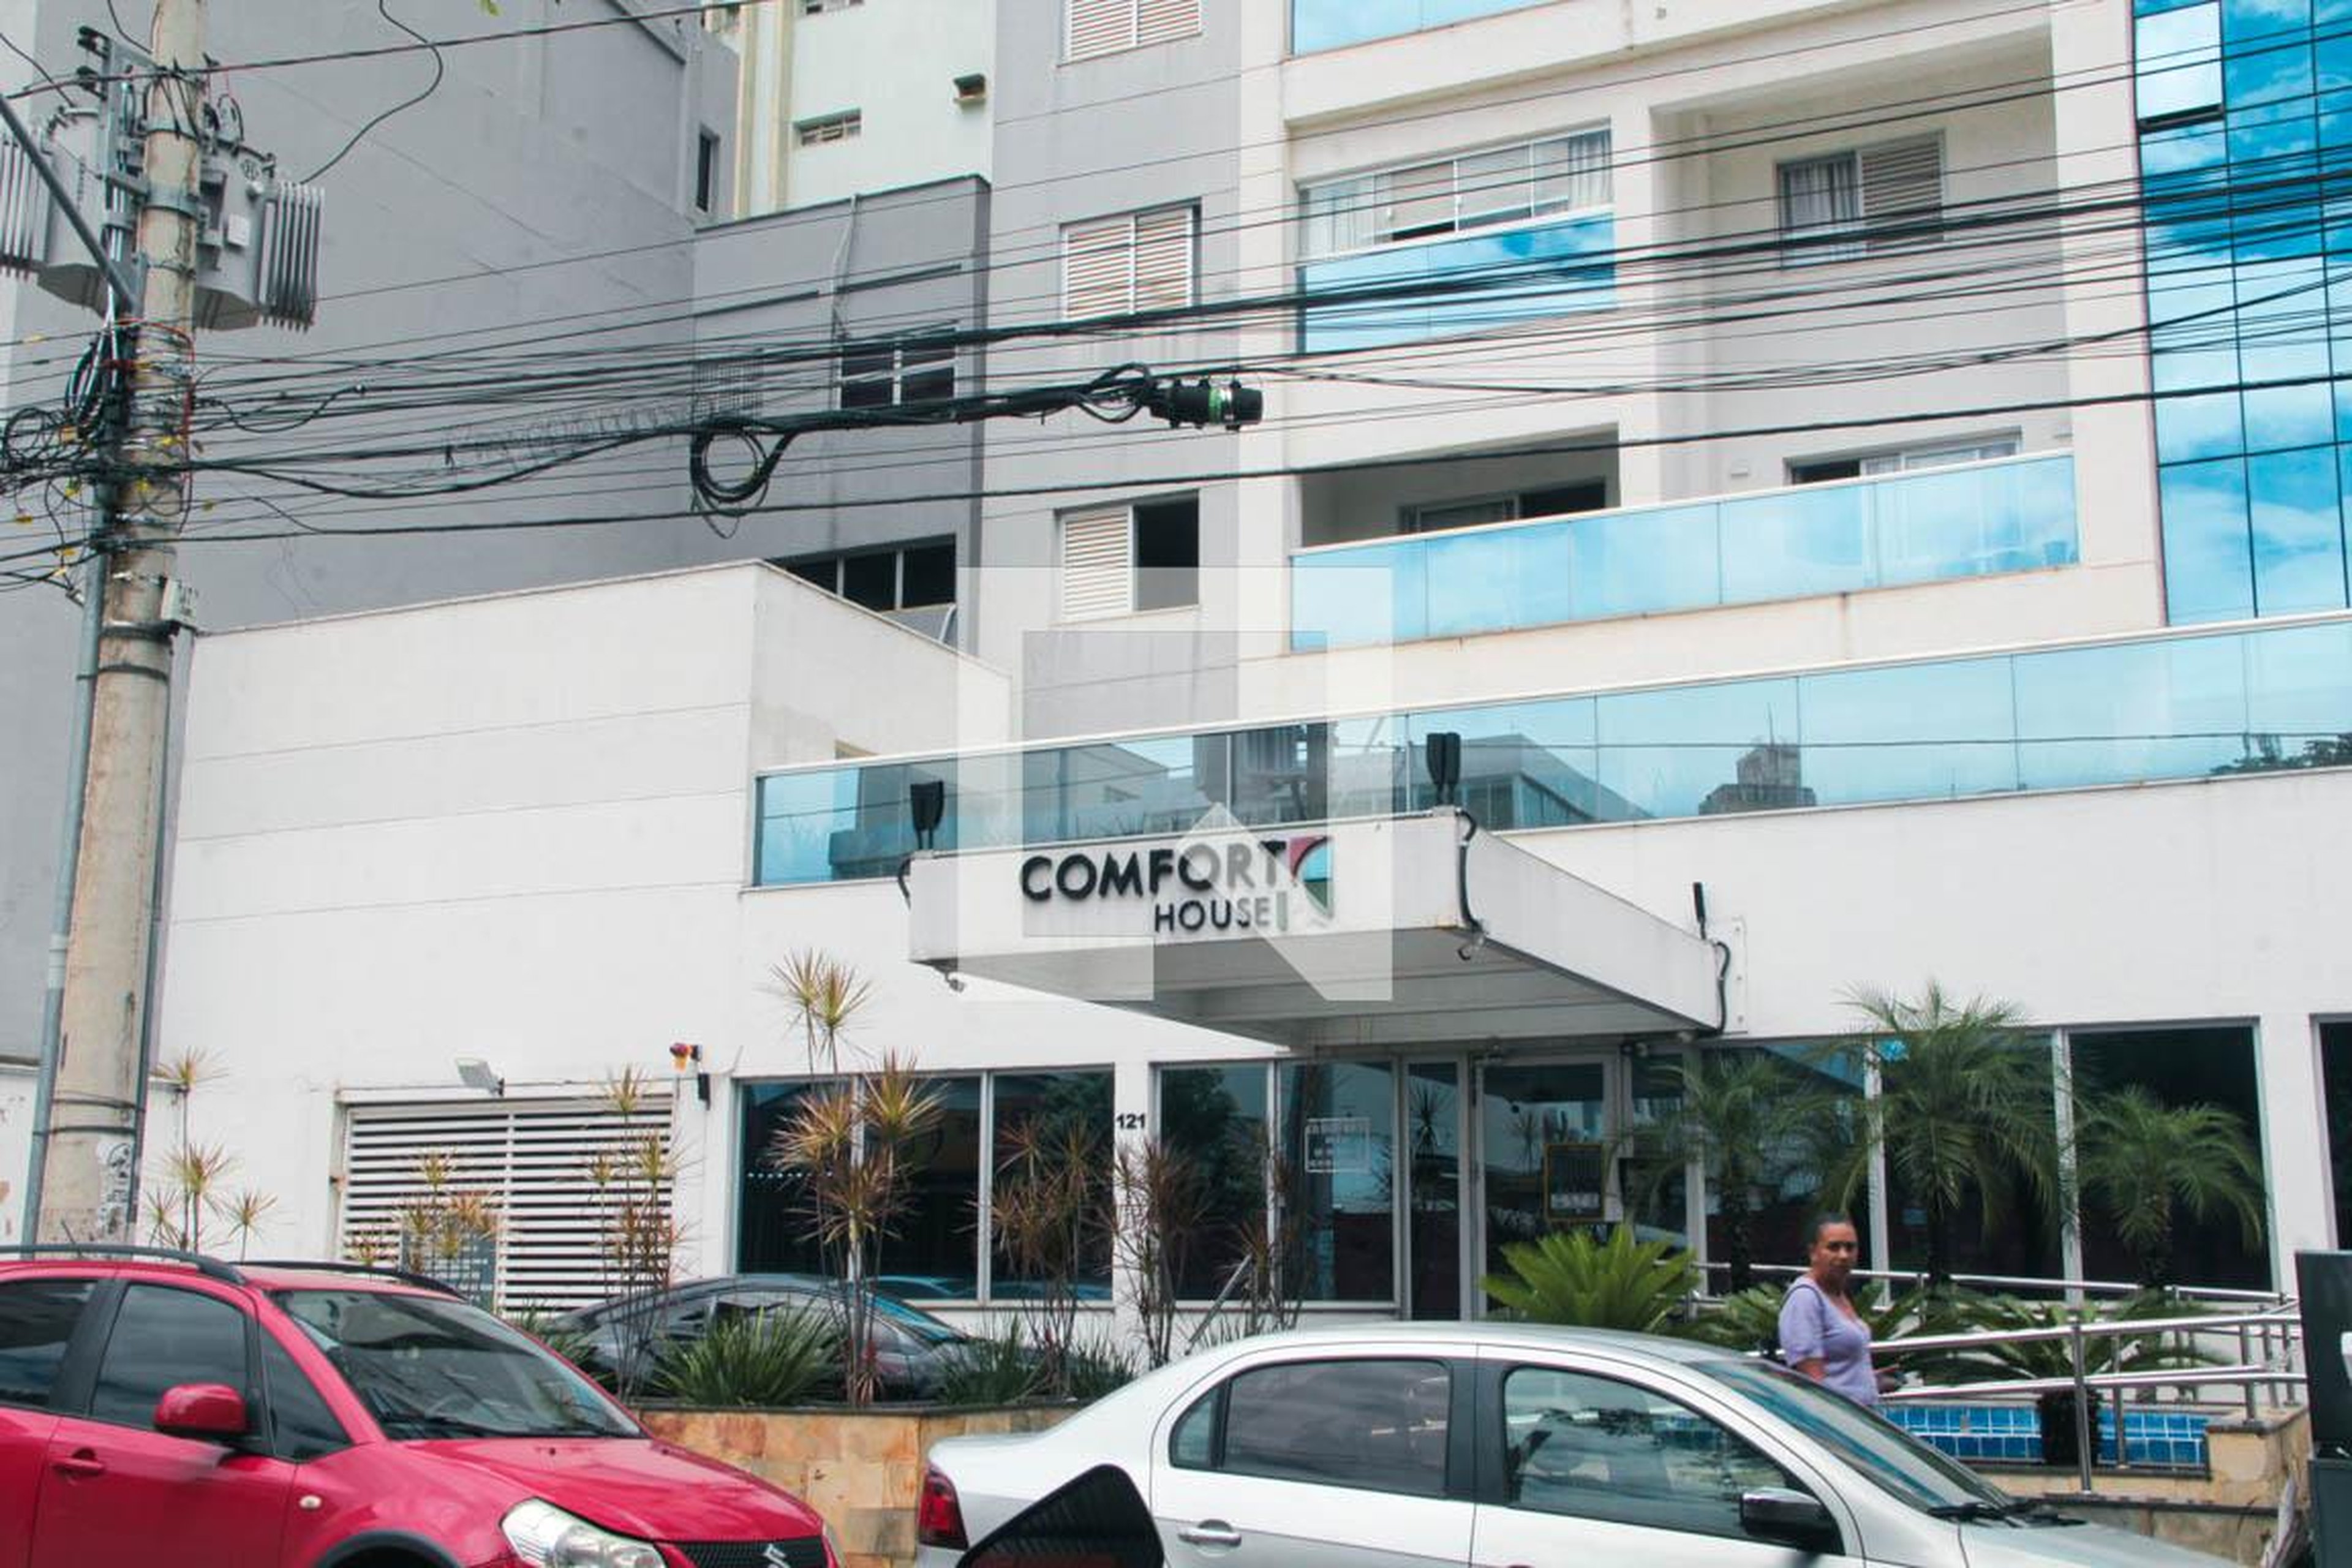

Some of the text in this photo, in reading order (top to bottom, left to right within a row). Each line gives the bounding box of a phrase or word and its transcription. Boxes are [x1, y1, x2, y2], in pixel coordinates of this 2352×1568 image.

[1021, 840, 1286, 901] COMFORT
[1154, 898, 1270, 932] HOUSE
[1116, 1114, 1145, 1129] 121
